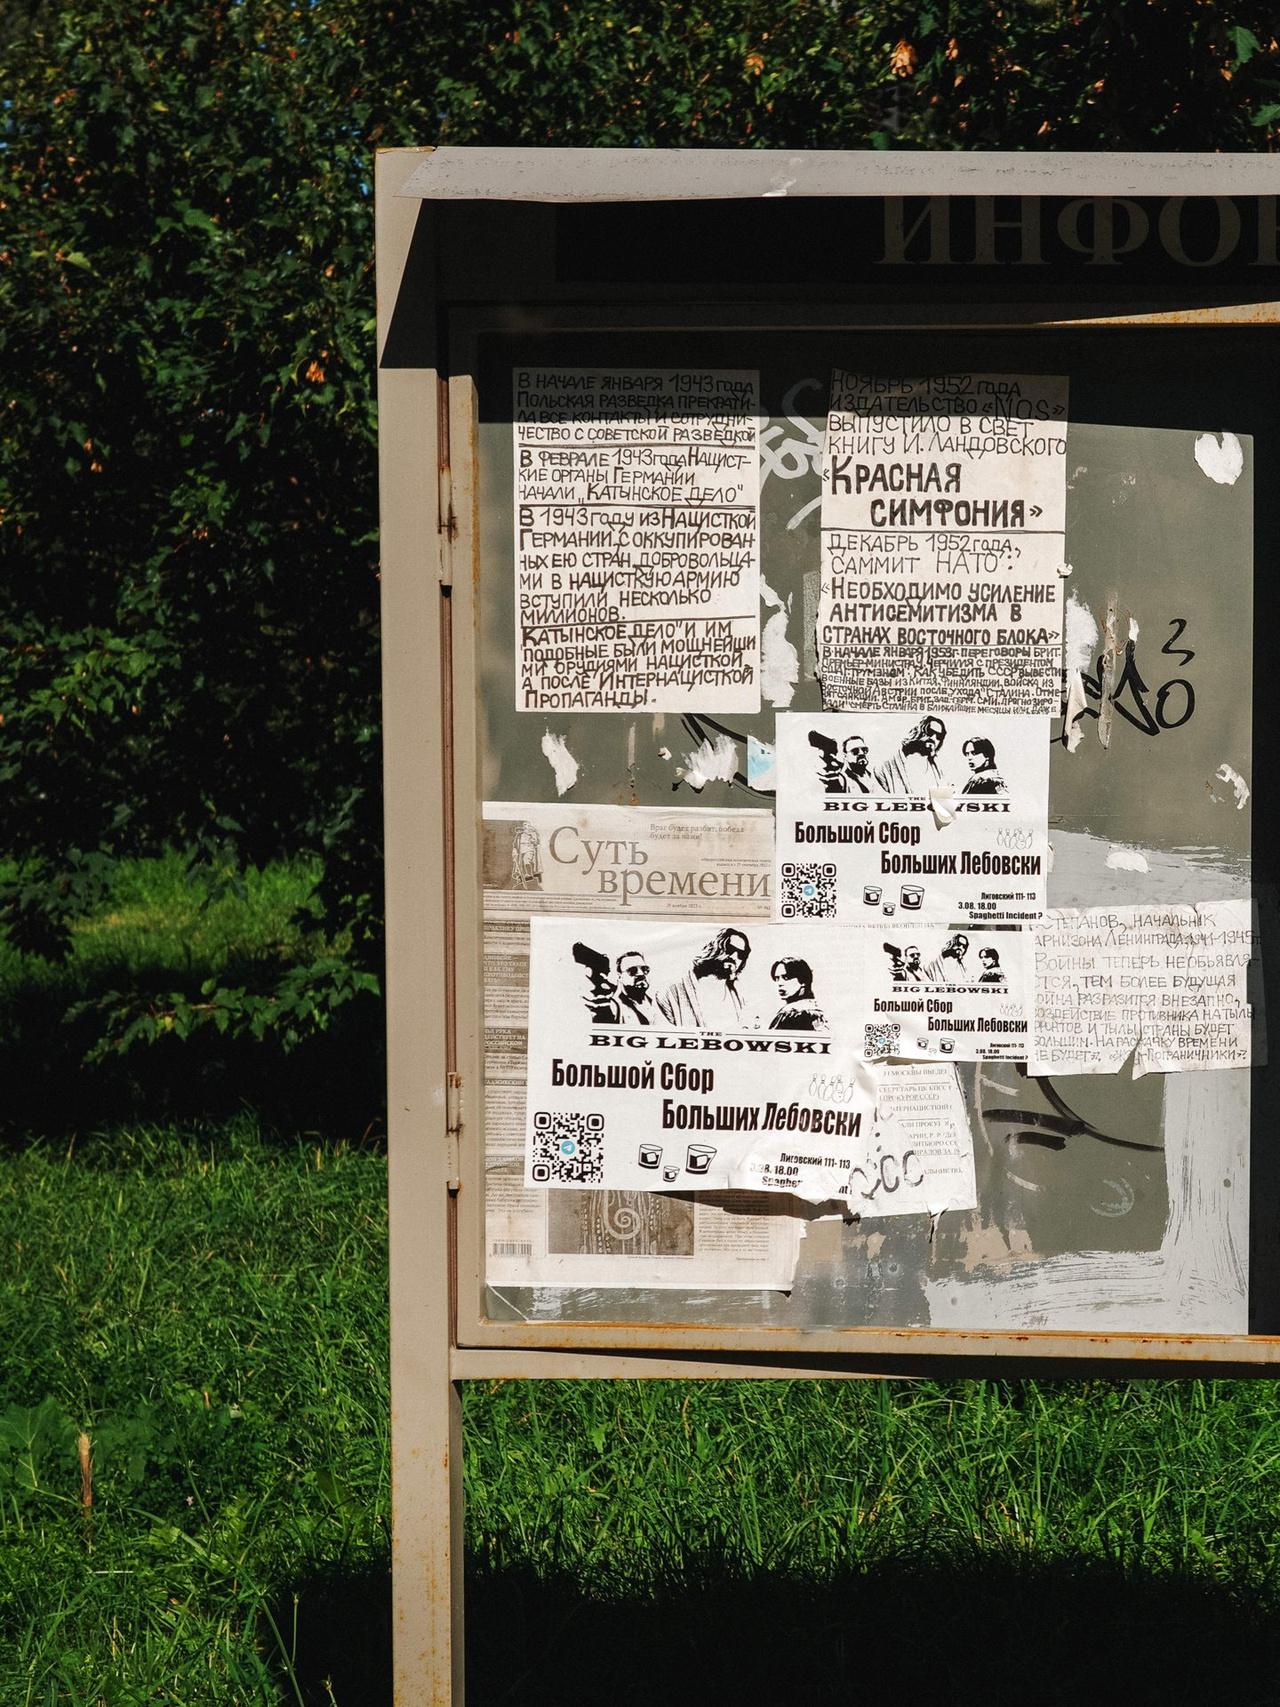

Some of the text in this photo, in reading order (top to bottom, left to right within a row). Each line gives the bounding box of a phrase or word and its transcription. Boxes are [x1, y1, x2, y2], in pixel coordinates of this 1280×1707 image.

[518, 427, 570, 440] ЧЕСТВО
[590, 425, 669, 442] СОВЕТСКОЙ
[829, 415, 1034, 438] ВЫПУСТИЛО В СВЕТ
[829, 435, 895, 455] КНИГУ
[552, 469, 608, 483] ОРГАНЫ
[519, 485, 575, 500] НАЧАЛИ
[827, 533, 918, 557] ДЕКАБРЬ
[831, 556, 920, 575] САММИТ
[672, 571, 740, 589] АРМИЮ
[520, 589, 712, 610] ВСТУПИЛИ НЕСКОЛЬКО
[968, 583, 1055, 603] УСИЛЕНИЕ
[830, 603, 1022, 623] АНТИСЕМИТИЗМА В
[823, 626, 891, 645] СТРАНАХ
[898, 629, 990, 646] ВОСТОЧНОГО
[823, 802, 869, 811] BIG
[794, 821, 920, 845] Большой Сбор
[548, 826, 648, 875] Суть
[881, 851, 1041, 875] Больших Лебовски
[598, 868, 771, 906] времени
[981, 892, 1014, 900] Лиговский
[969, 911, 1036, 920] Spaghetti Incident
[978, 902, 996, 910] 18.00
[874, 998, 953, 1014] Большой Сбор
[928, 1017, 1028, 1033] Больших Лебовски
[589, 1034, 831, 1054] BIG LEBOWSKI
[1178, 1038, 1238, 1048] ВРЕМЕНИ
[551, 1058, 714, 1094] Большой Сбор
[662, 1099, 862, 1137] Больших Лебовски
[780, 1152, 822, 1167] Лиговский
